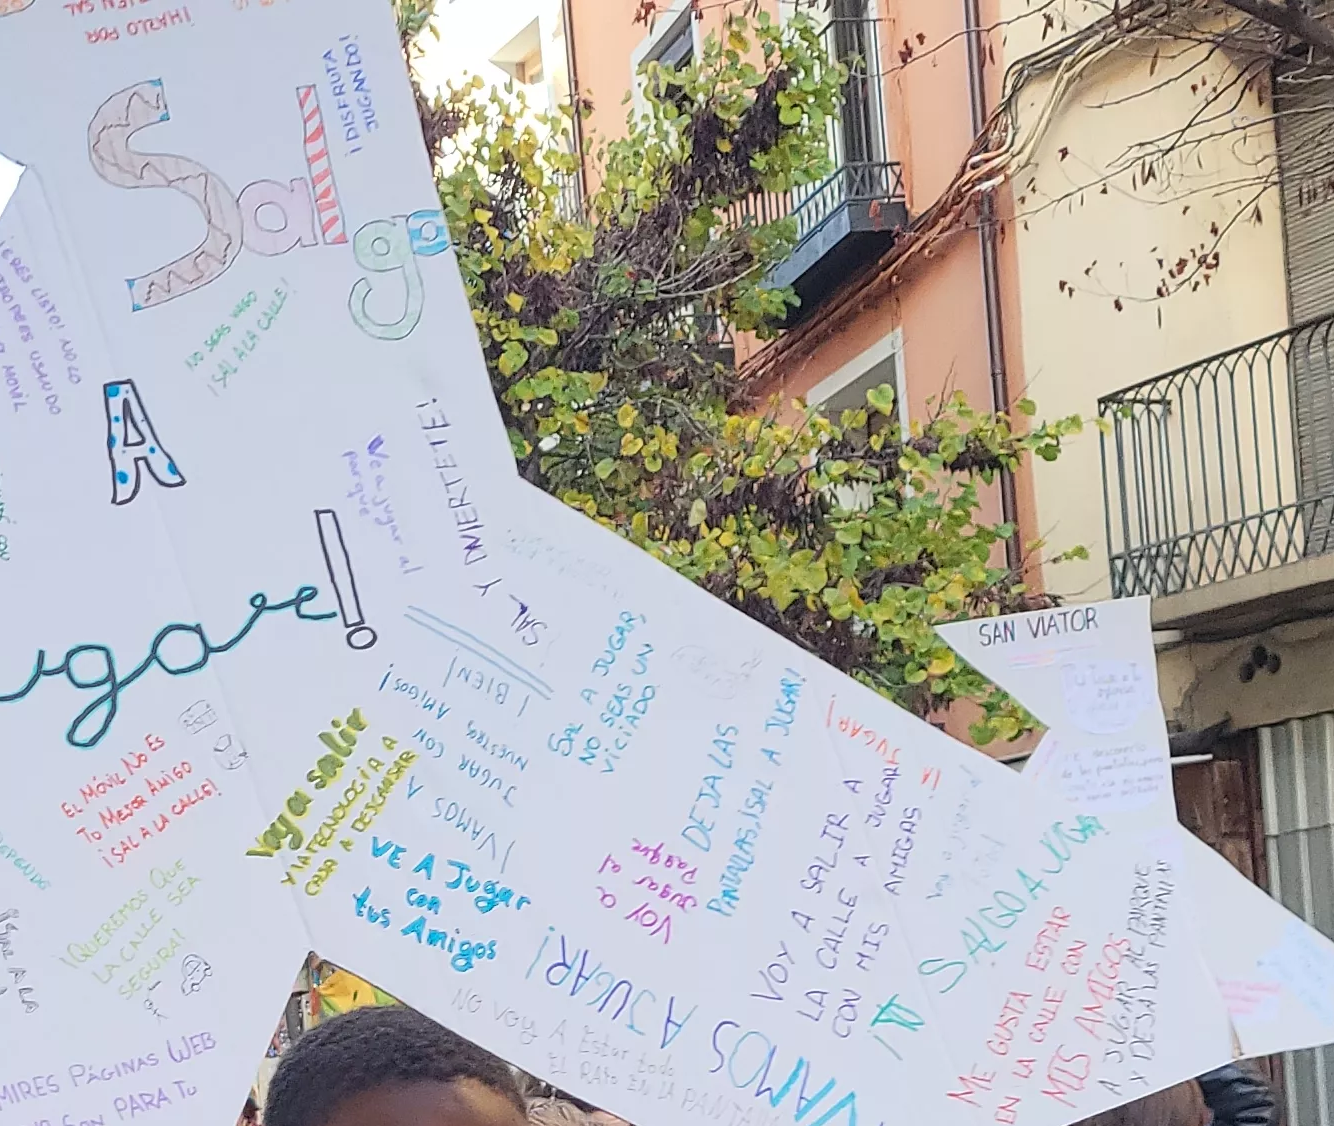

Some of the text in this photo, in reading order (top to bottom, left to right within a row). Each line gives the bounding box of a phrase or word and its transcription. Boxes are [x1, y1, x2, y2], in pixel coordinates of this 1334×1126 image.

[88, 77, 455, 341] Salgo
[103, 379, 187, 505] A
[472, 577, 503, 597] Y
[978, 606, 1100, 647] SAN VIATOR
[578, 686, 599, 707] A
[578, 642, 656, 767] NO SEAS UN
[382, 735, 399, 751] A
[411, 727, 518, 808] JUGAR CON
[707, 722, 740, 771] LAS
[760, 746, 784, 768] A
[139, 824, 155, 841] A
[152, 813, 172, 833] LA
[370, 835, 407, 870] VE
[412, 852, 436, 882] A
[1015, 868, 1051, 901] A
[750, 777, 865, 1003] VOY A SALIR A
[795, 765, 903, 1023] LA CALLE A JUGAR
[91, 875, 204, 986] LA CALLE SEA
[400, 914, 499, 974] Amigos
[830, 986, 864, 1040] CON
[854, 920, 891, 973] MIS
[946, 905, 1073, 1108] ME GUSTA ESTAR
[1072, 932, 1133, 1042] AMIGOS
[165, 1031, 218, 1065] WEB
[660, 995, 700, 1050] A
[993, 939, 1090, 1125] EN LA CALLE CON
[112, 1086, 174, 1122] PARA
[1096, 1078, 1124, 1098] A
